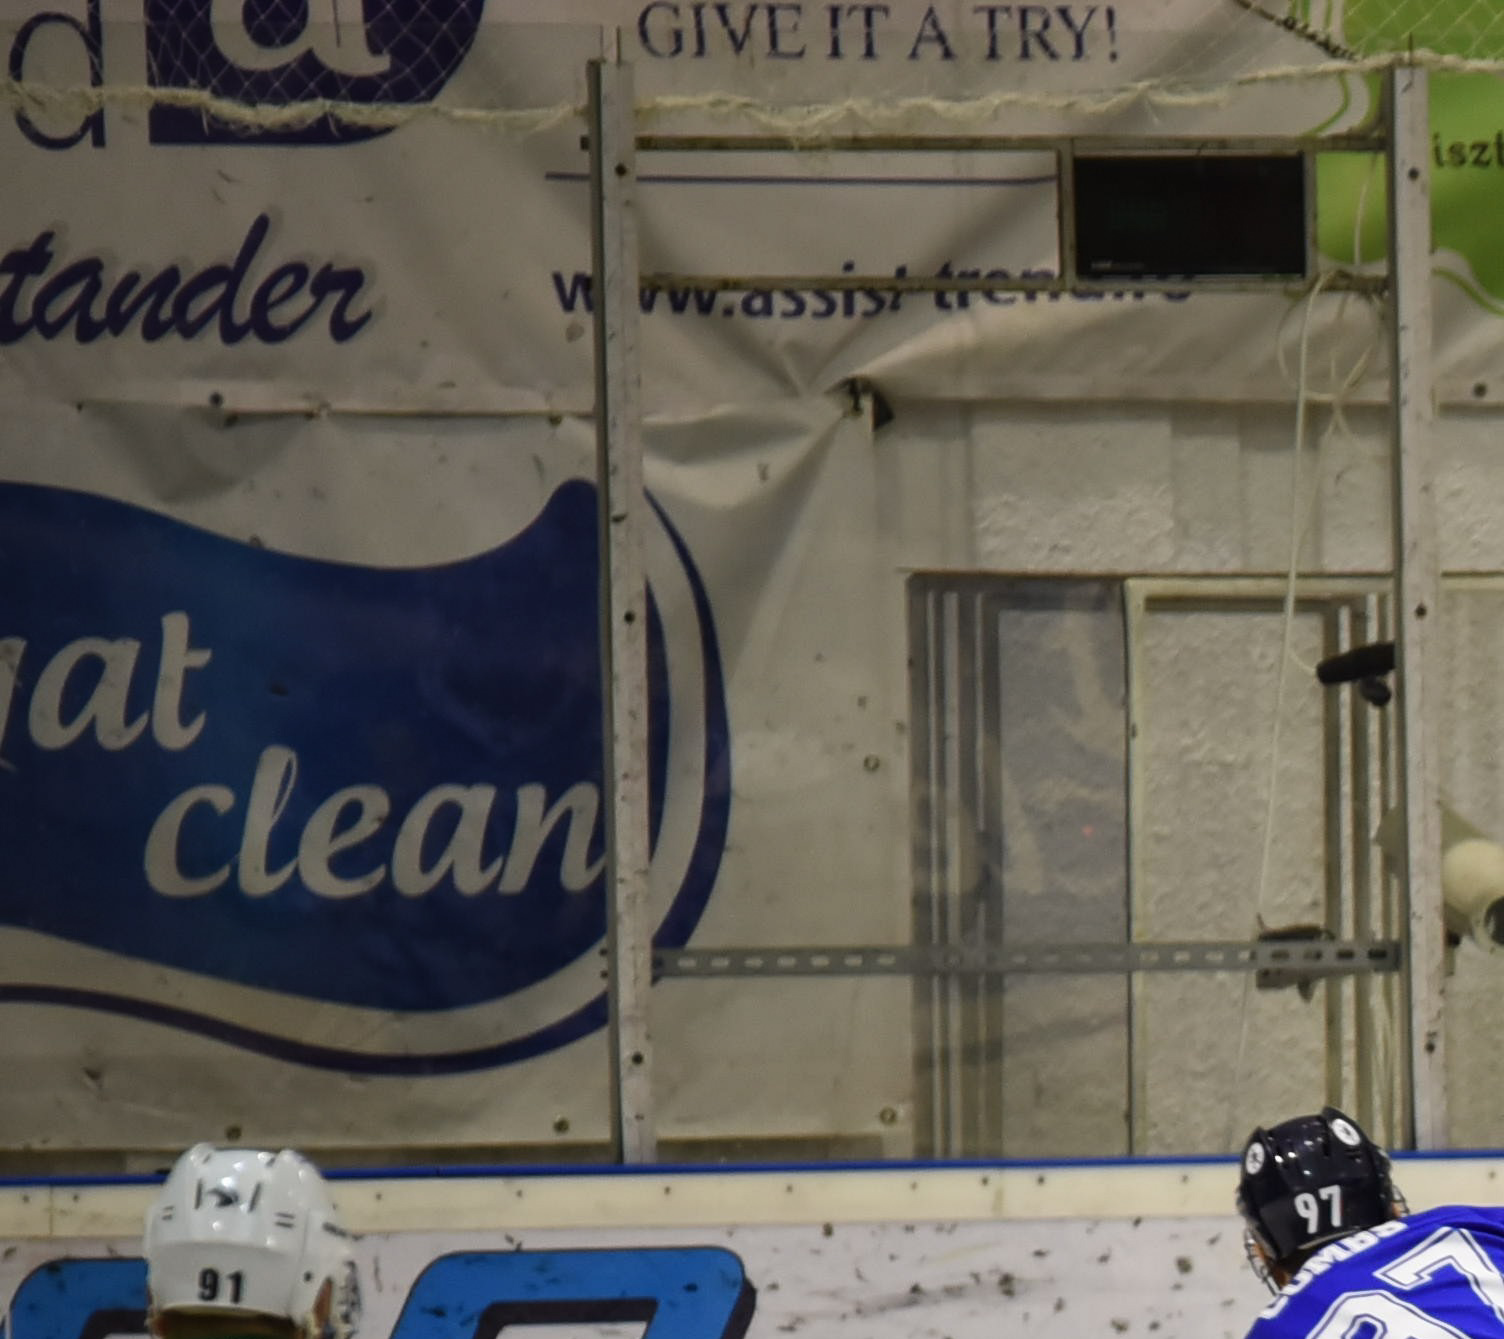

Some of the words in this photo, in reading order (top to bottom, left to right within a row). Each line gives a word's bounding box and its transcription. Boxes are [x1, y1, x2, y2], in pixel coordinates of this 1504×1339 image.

[638, 2, 806, 61] GIVE
[827, 3, 894, 61] IT
[910, 5, 957, 61] A
[974, 3, 1120, 62] TRY!
[145, 745, 608, 898] clean
[1294, 1184, 1343, 1235] 97
[199, 1268, 244, 1305] 91
